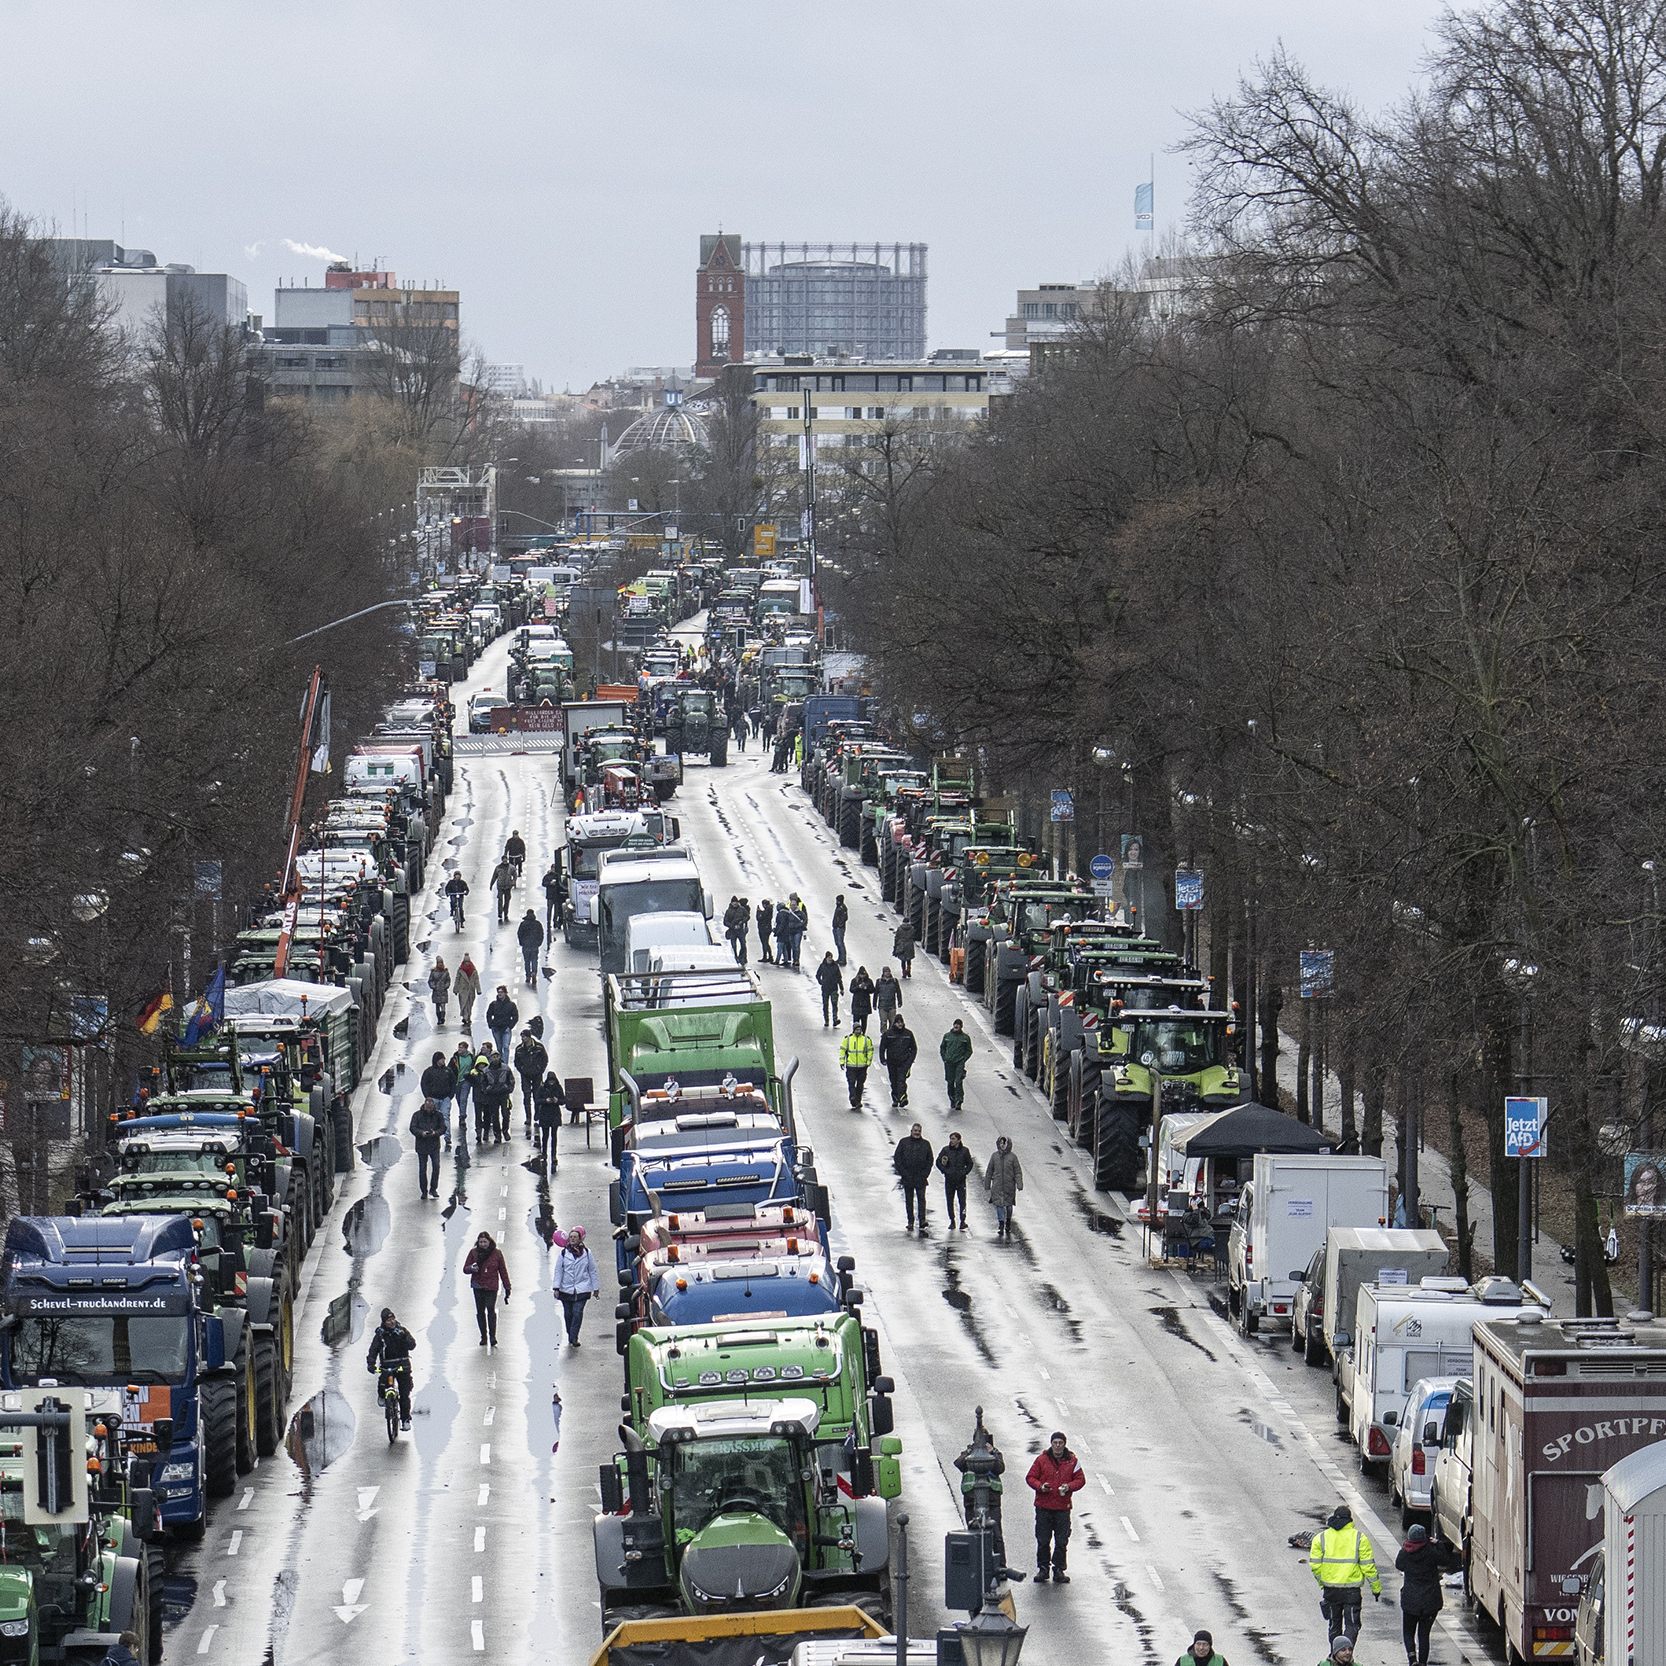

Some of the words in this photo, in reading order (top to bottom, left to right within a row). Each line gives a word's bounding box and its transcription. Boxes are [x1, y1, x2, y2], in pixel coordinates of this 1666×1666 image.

[666, 393, 675, 404] U
[1507, 1117, 1538, 1134] Jetzt
[1508, 1131, 1534, 1147] AfD
